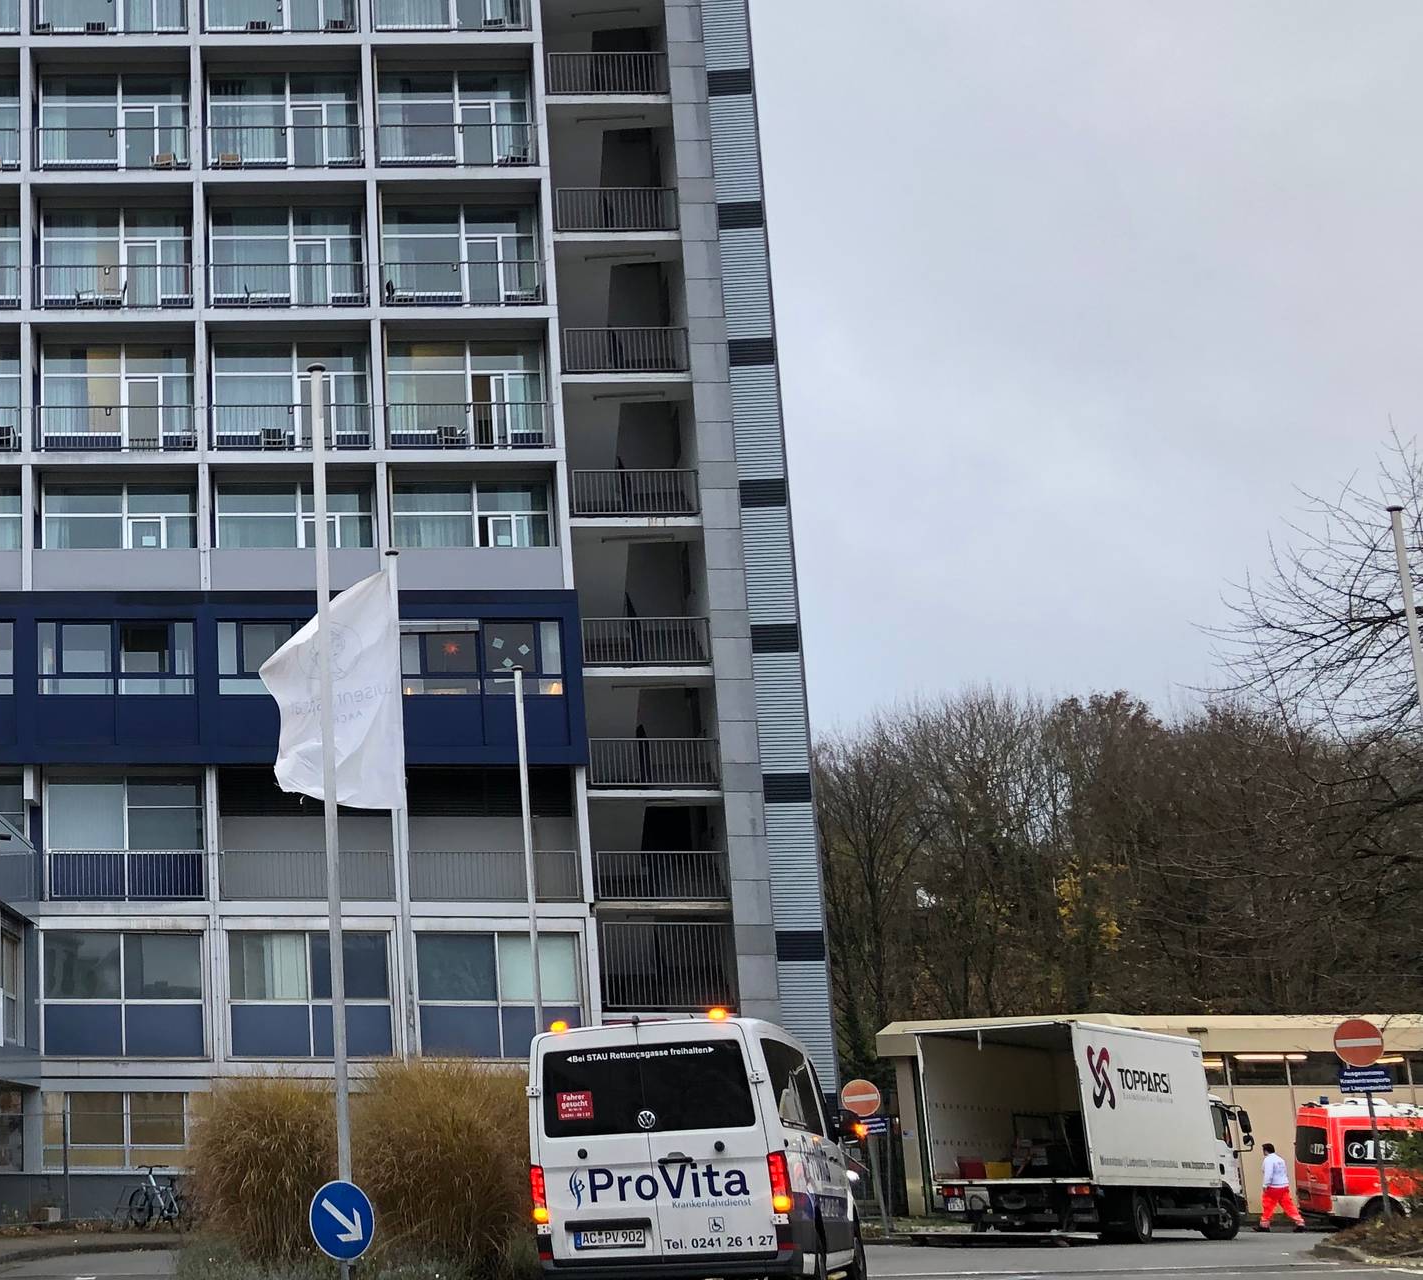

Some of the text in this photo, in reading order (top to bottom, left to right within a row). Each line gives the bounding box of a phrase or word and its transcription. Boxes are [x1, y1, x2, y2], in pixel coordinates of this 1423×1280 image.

[572, 1055, 585, 1063] Bei
[587, 1053, 608, 1062] STAU
[670, 1047, 708, 1056] freihalten
[1117, 1068, 1169, 1093] TOPPARS
[562, 1093, 585, 1101] Fahrer
[561, 1100, 588, 1110] gesucht
[588, 1163, 750, 1203] ProVita
[672, 1198, 752, 1209] Krankenfahrdienst
[583, 1230, 643, 1244] AC PV 902
[664, 1235, 774, 1249] Tel. 0241 26 1 27
